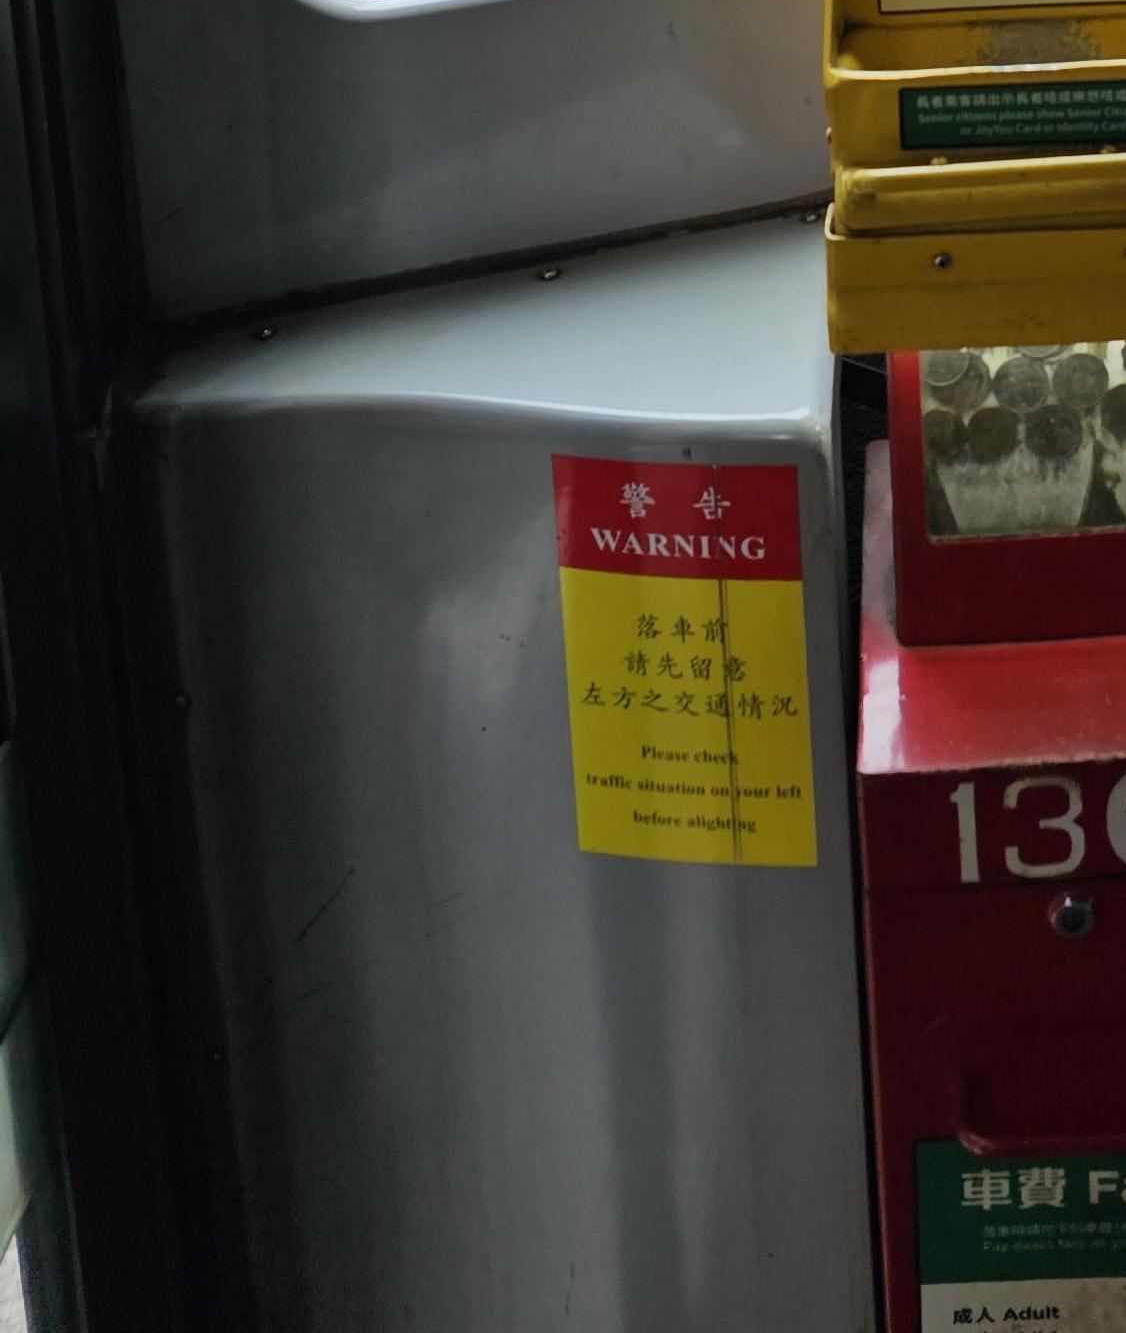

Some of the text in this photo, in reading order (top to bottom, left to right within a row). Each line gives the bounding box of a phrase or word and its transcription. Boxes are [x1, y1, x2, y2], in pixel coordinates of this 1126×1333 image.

[918, 112, 954, 124] Senior
[956, 111, 997, 123] citizens
[999, 110, 1034, 122] please
[1036, 108, 1065, 119] show
[1067, 107, 1101, 118] Senior
[1016, 123, 1041, 134] Card
[1057, 121, 1099, 134] Identity
[620, 482, 732, 520] 警告
[590, 526, 766, 561] WARNING
[635, 613, 729, 647] 落車前
[623, 652, 748, 684] 請先留意
[640, 743, 740, 766] Please check
[586, 771, 802, 802] traffic situation on your left
[632, 808, 757, 834] before alighting
[961, 1167, 1067, 1211] 車費
[953, 1306, 995, 1325] 成人
[1003, 1306, 1060, 1322] Adult
